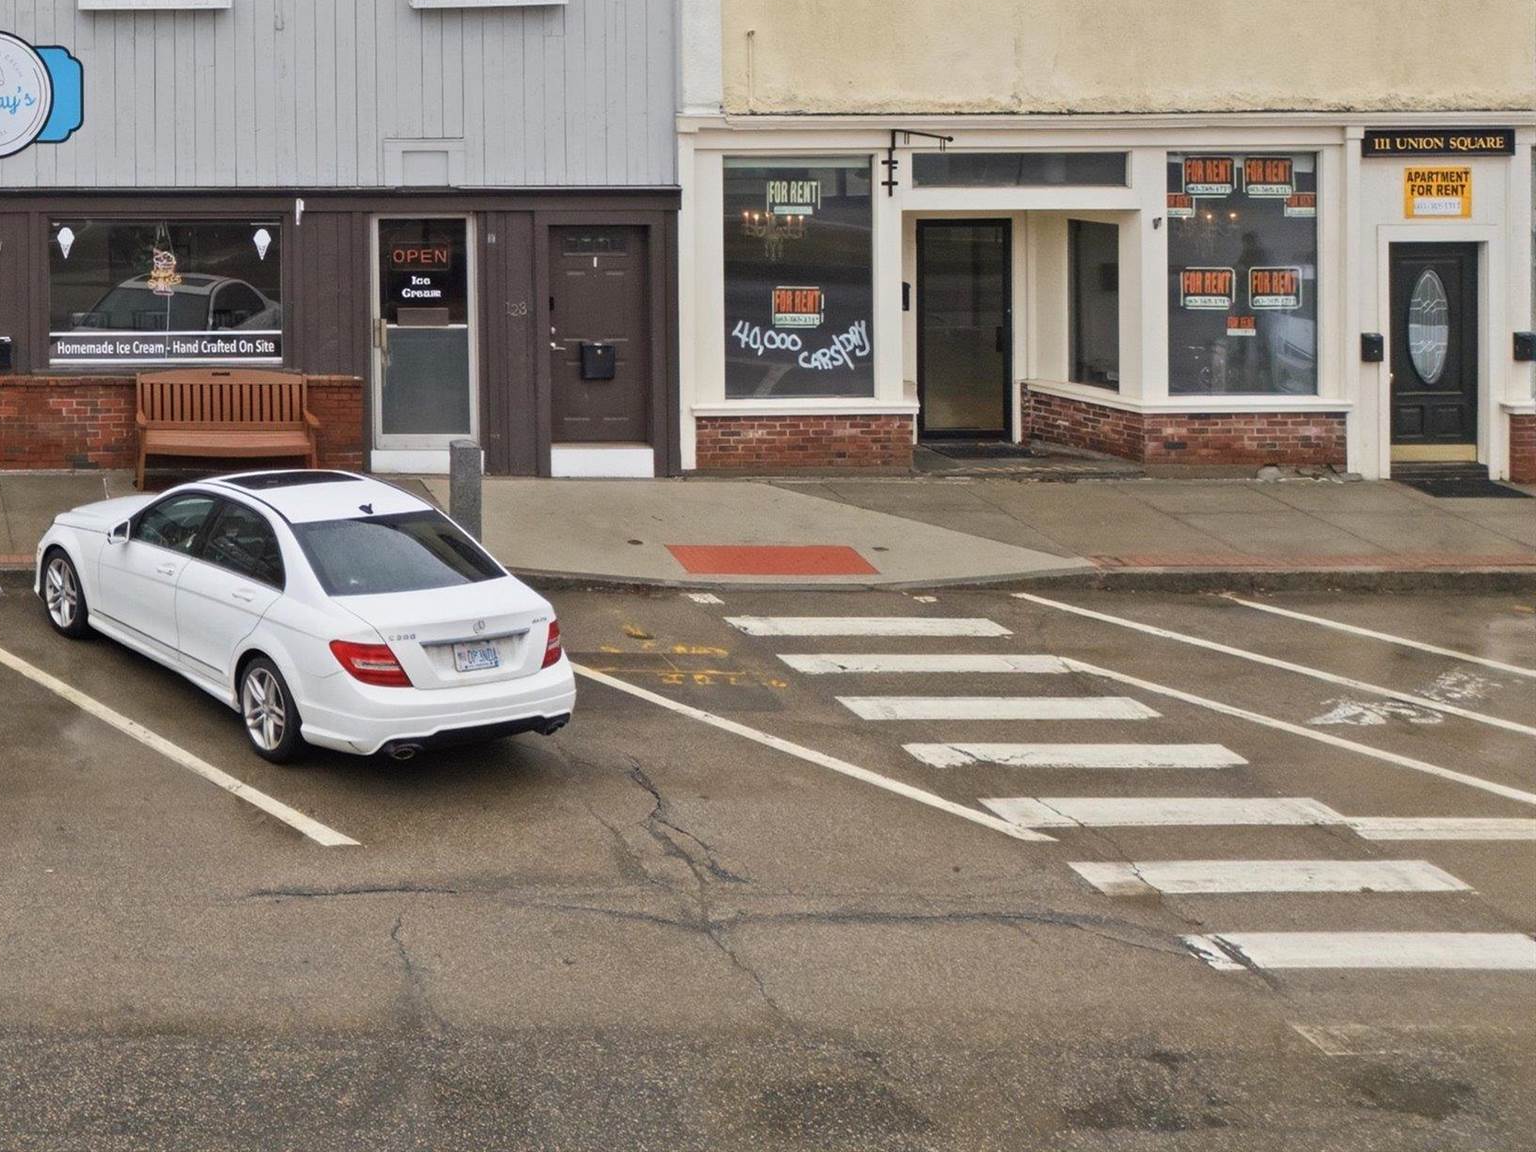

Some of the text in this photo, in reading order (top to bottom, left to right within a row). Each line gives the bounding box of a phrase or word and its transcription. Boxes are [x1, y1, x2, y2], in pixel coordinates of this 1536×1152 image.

[1396, 137, 1444, 149] UNION
[1449, 136, 1504, 151] SQUARE
[1186, 159, 1232, 183] FOR RENT
[1246, 159, 1291, 183] FOR RENT
[1407, 171, 1470, 183] APARTMENT
[769, 181, 817, 203] FOR RENT
[1411, 184, 1466, 196] FOR RENT
[392, 249, 448, 263] OPEN
[411, 275, 431, 285] Ice
[1184, 271, 1231, 294] FOR RENT
[1253, 271, 1298, 294] FOR RENT
[402, 288, 442, 298] Cream
[775, 290, 821, 313] FOR RENT
[732, 319, 803, 356] 40,000
[57, 341, 114, 354] Homemade
[116, 341, 130, 354] Ice
[132, 341, 164, 353] Cream
[173, 340, 199, 353] Hand
[201, 340, 236, 353] Crafted
[239, 340, 254, 353] On
[255, 340, 275, 352] Site
